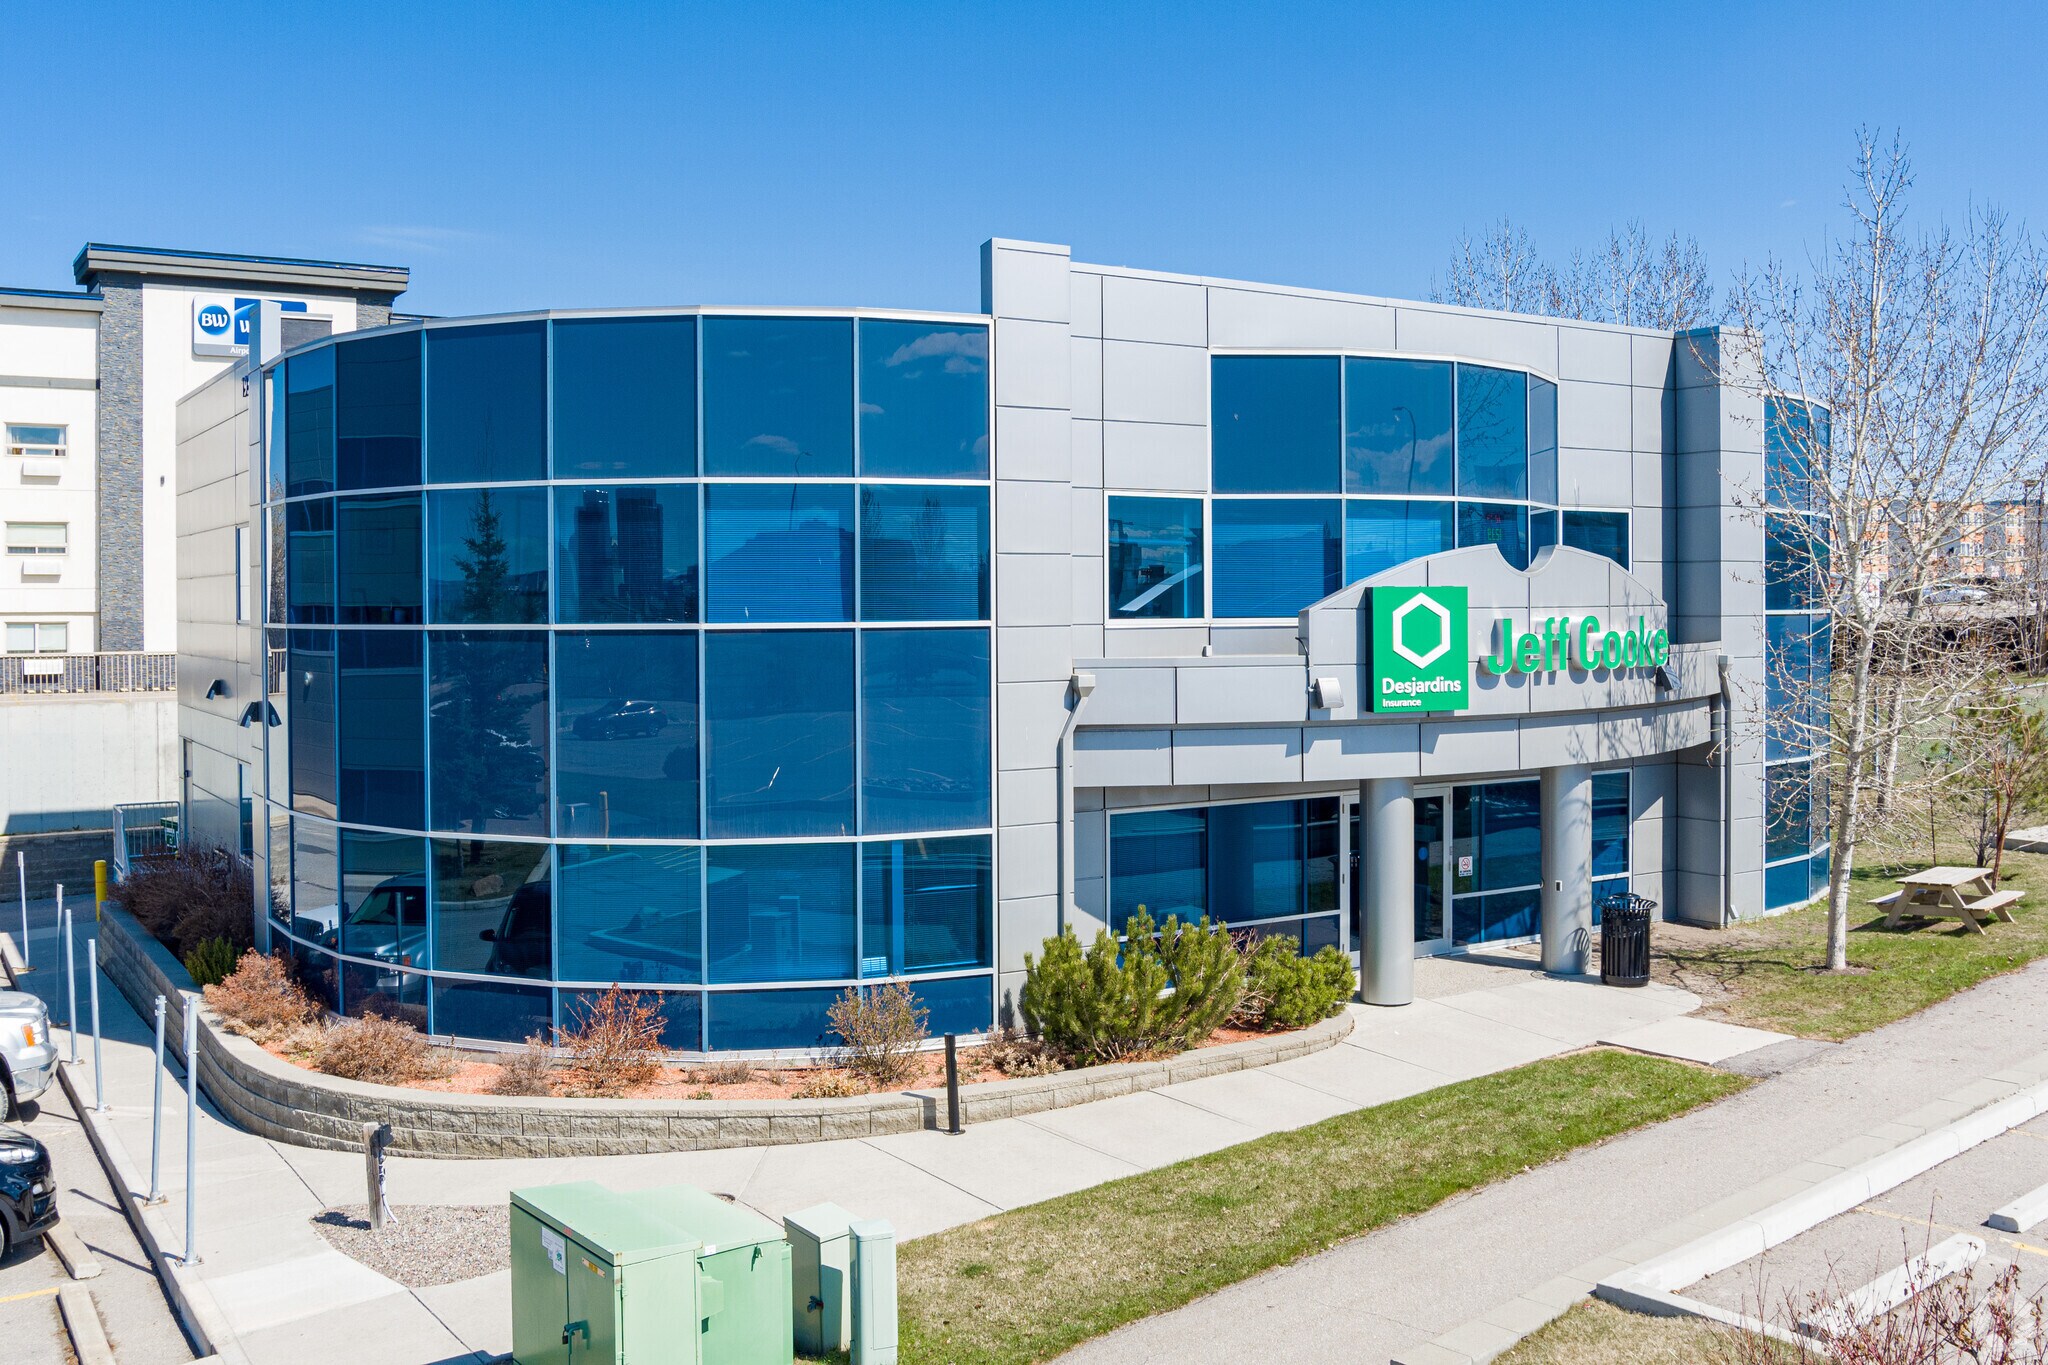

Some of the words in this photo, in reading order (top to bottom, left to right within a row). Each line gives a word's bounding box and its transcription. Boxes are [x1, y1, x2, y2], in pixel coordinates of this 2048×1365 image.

[201, 313, 228, 328] BW
[1487, 616, 1570, 675] Jeff
[1579, 615, 1669, 671] Cooke
[1382, 676, 1462, 697] Desjardins
[1382, 699, 1422, 708] Insurance
